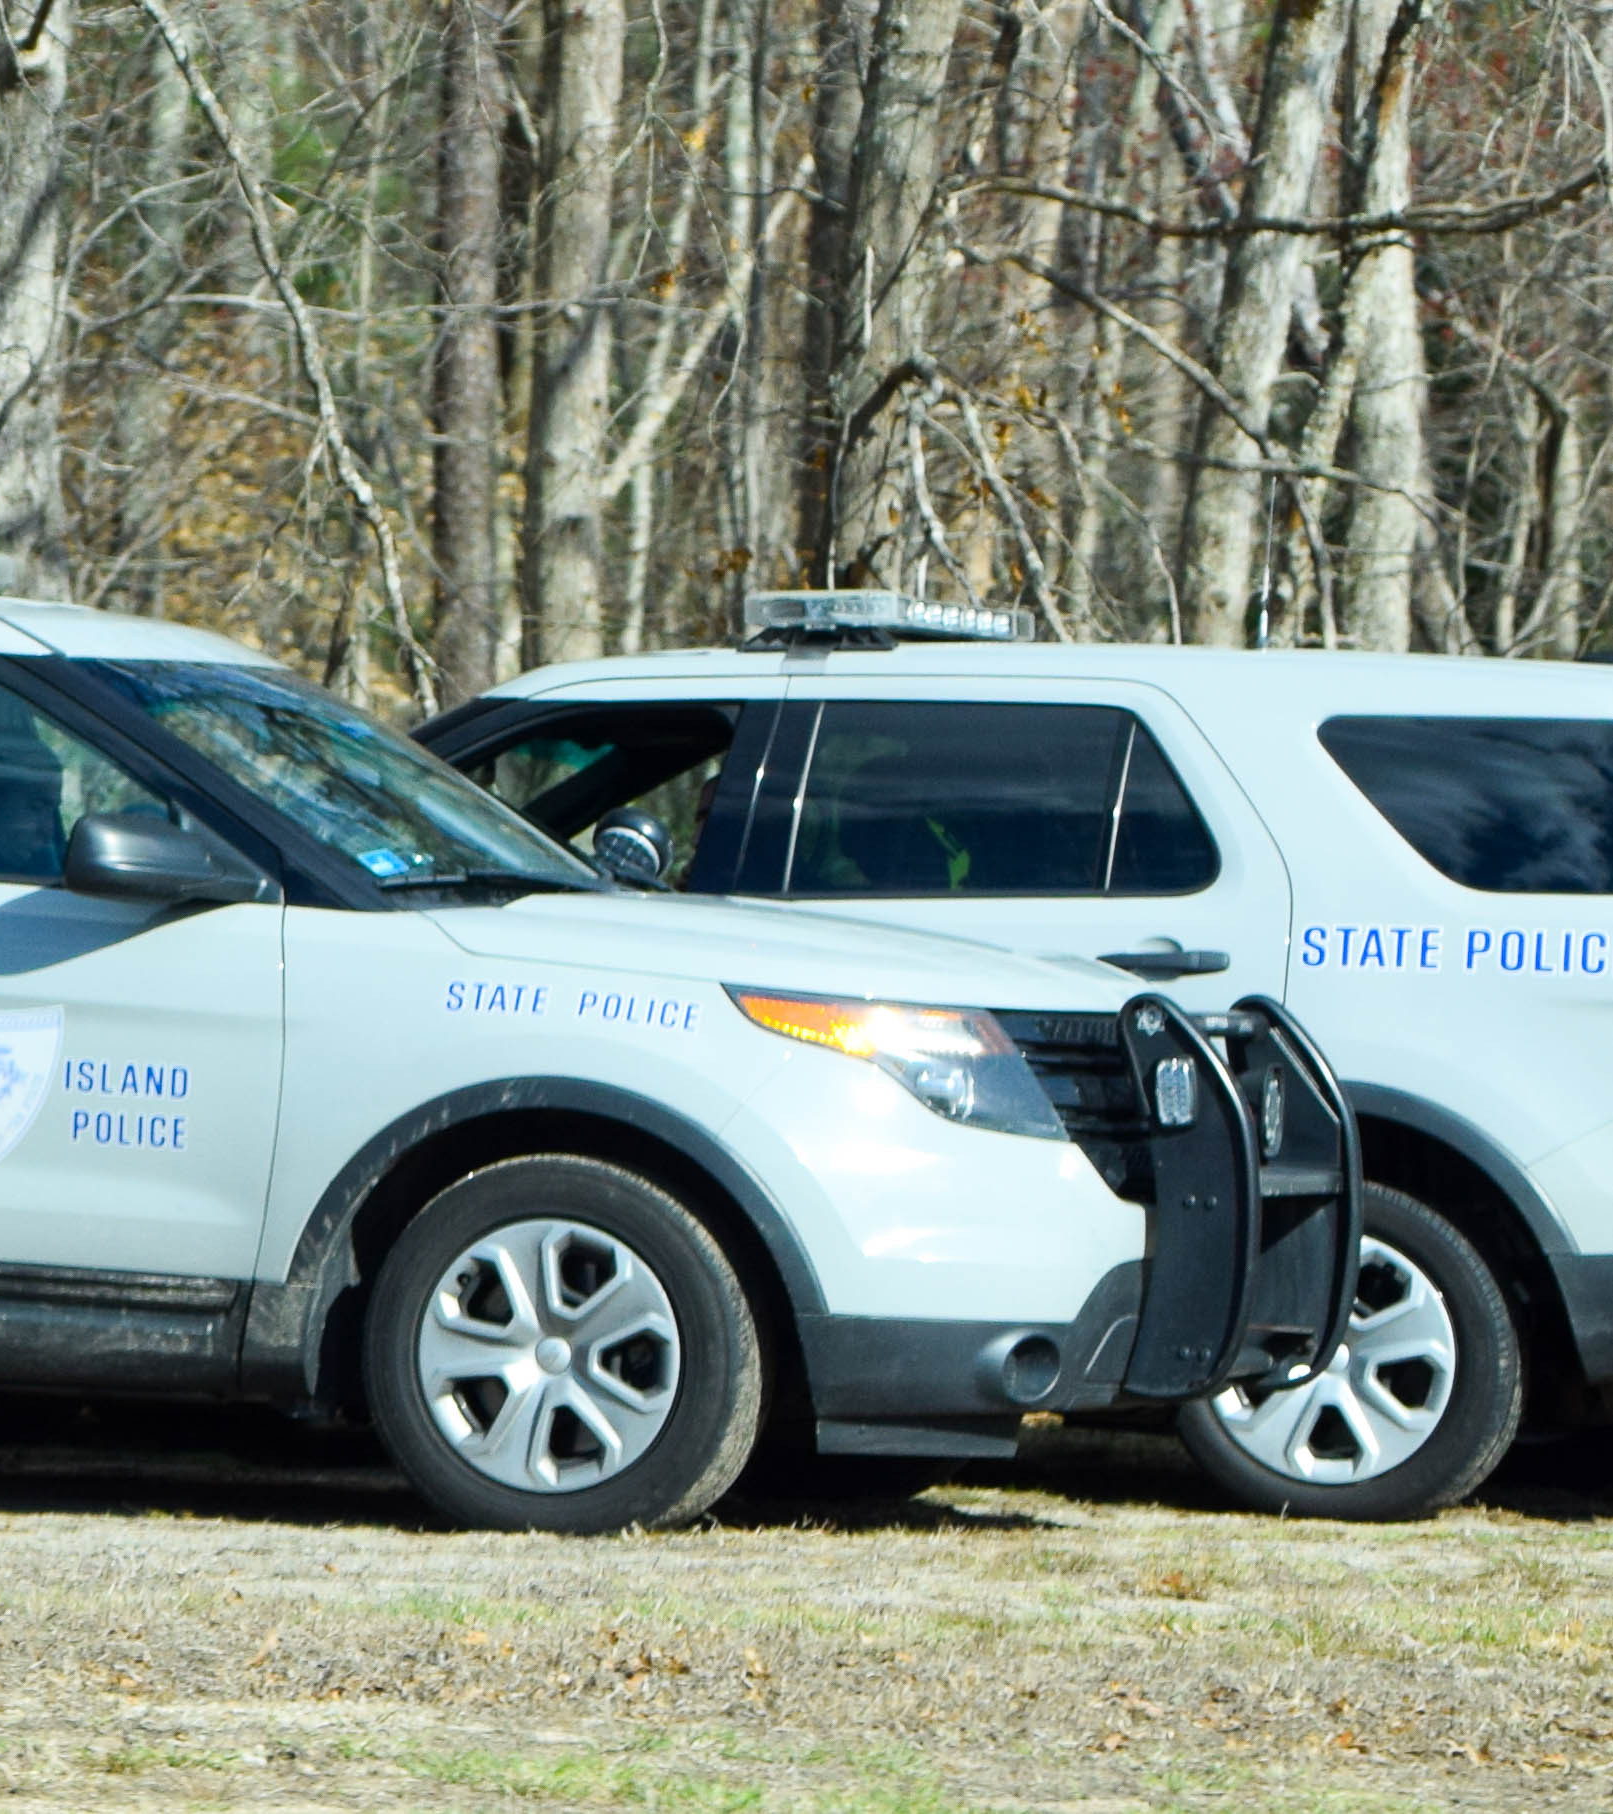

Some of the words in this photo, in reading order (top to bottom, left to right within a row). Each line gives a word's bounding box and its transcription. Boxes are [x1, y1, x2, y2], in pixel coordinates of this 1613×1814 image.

[1301, 926, 1439, 969] STATE
[1465, 929, 1613, 976] POLIC
[445, 981, 548, 1016] STATE
[577, 991, 700, 1031] POLICE
[64, 1059, 189, 1099] ISLAND
[72, 1109, 187, 1149] POLICE
